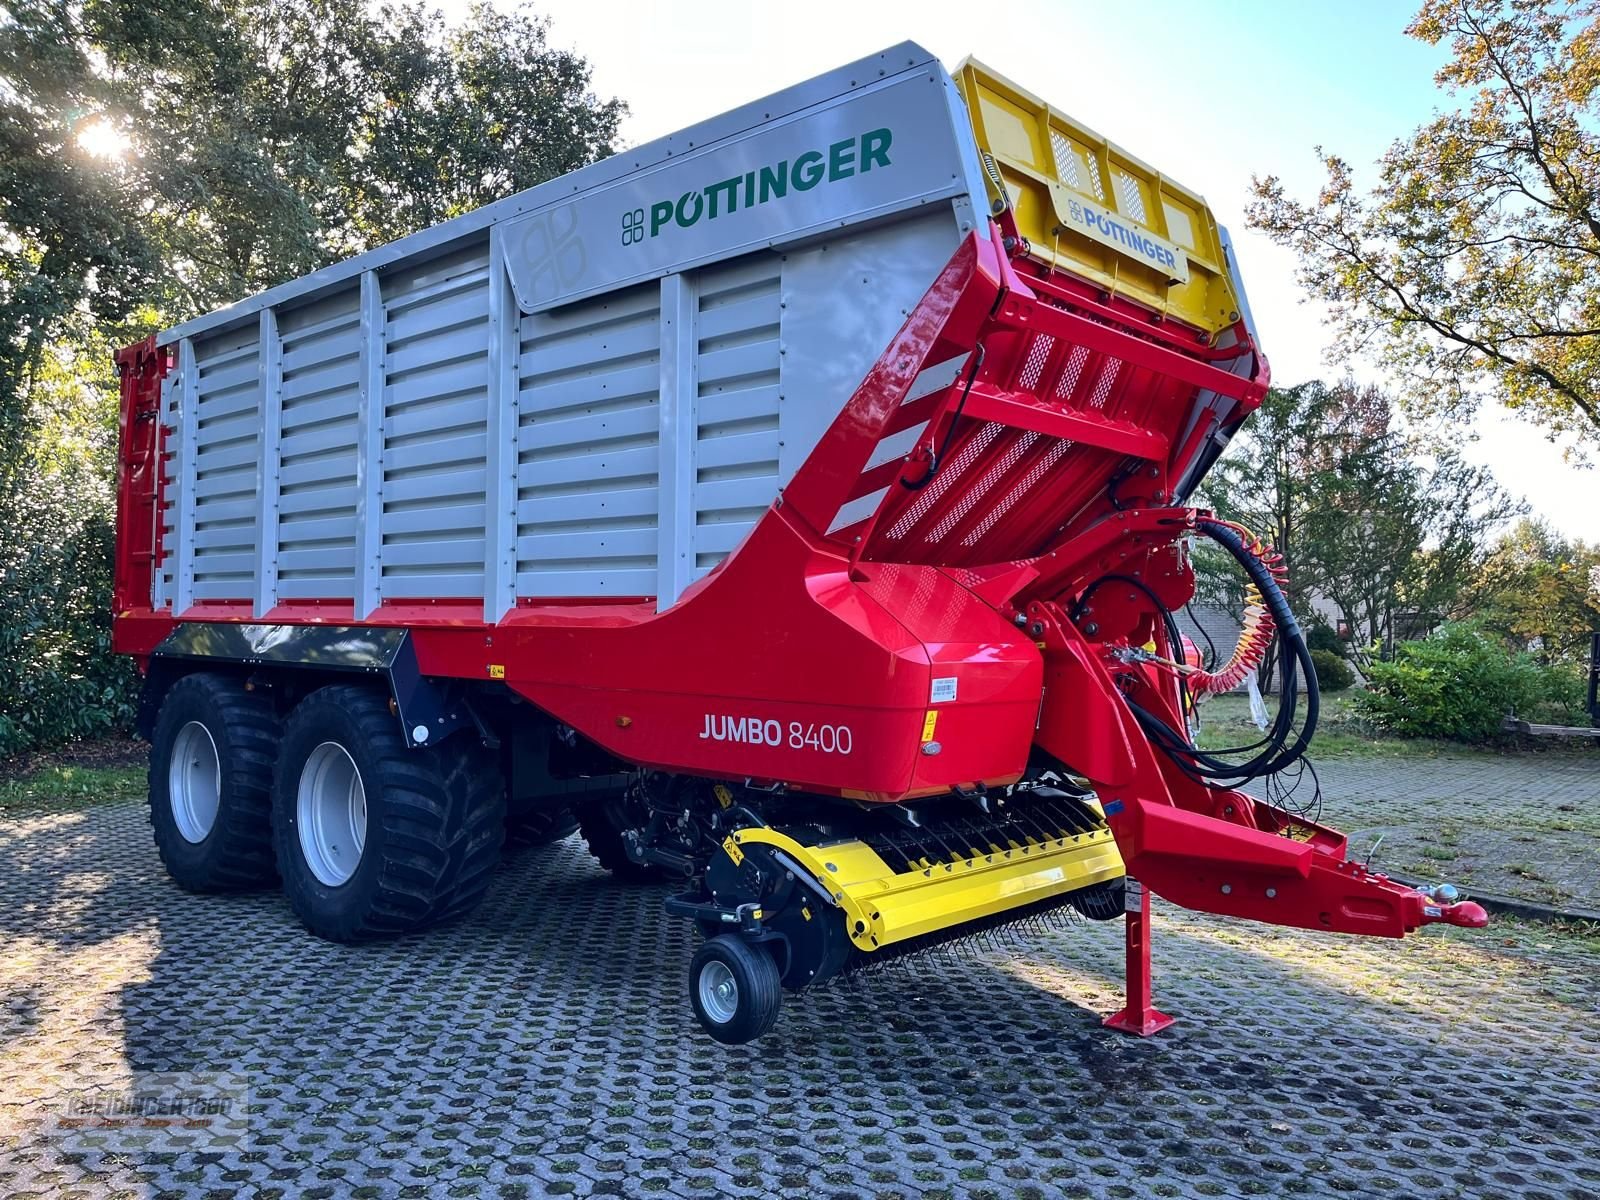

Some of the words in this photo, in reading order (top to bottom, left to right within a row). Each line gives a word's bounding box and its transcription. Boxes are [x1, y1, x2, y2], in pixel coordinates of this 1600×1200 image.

[650, 128, 892, 238] PÖTTINGER
[1083, 207, 1177, 270] PÖTTINGER
[699, 714, 782, 747] JUMBO
[788, 721, 852, 755] 8400
